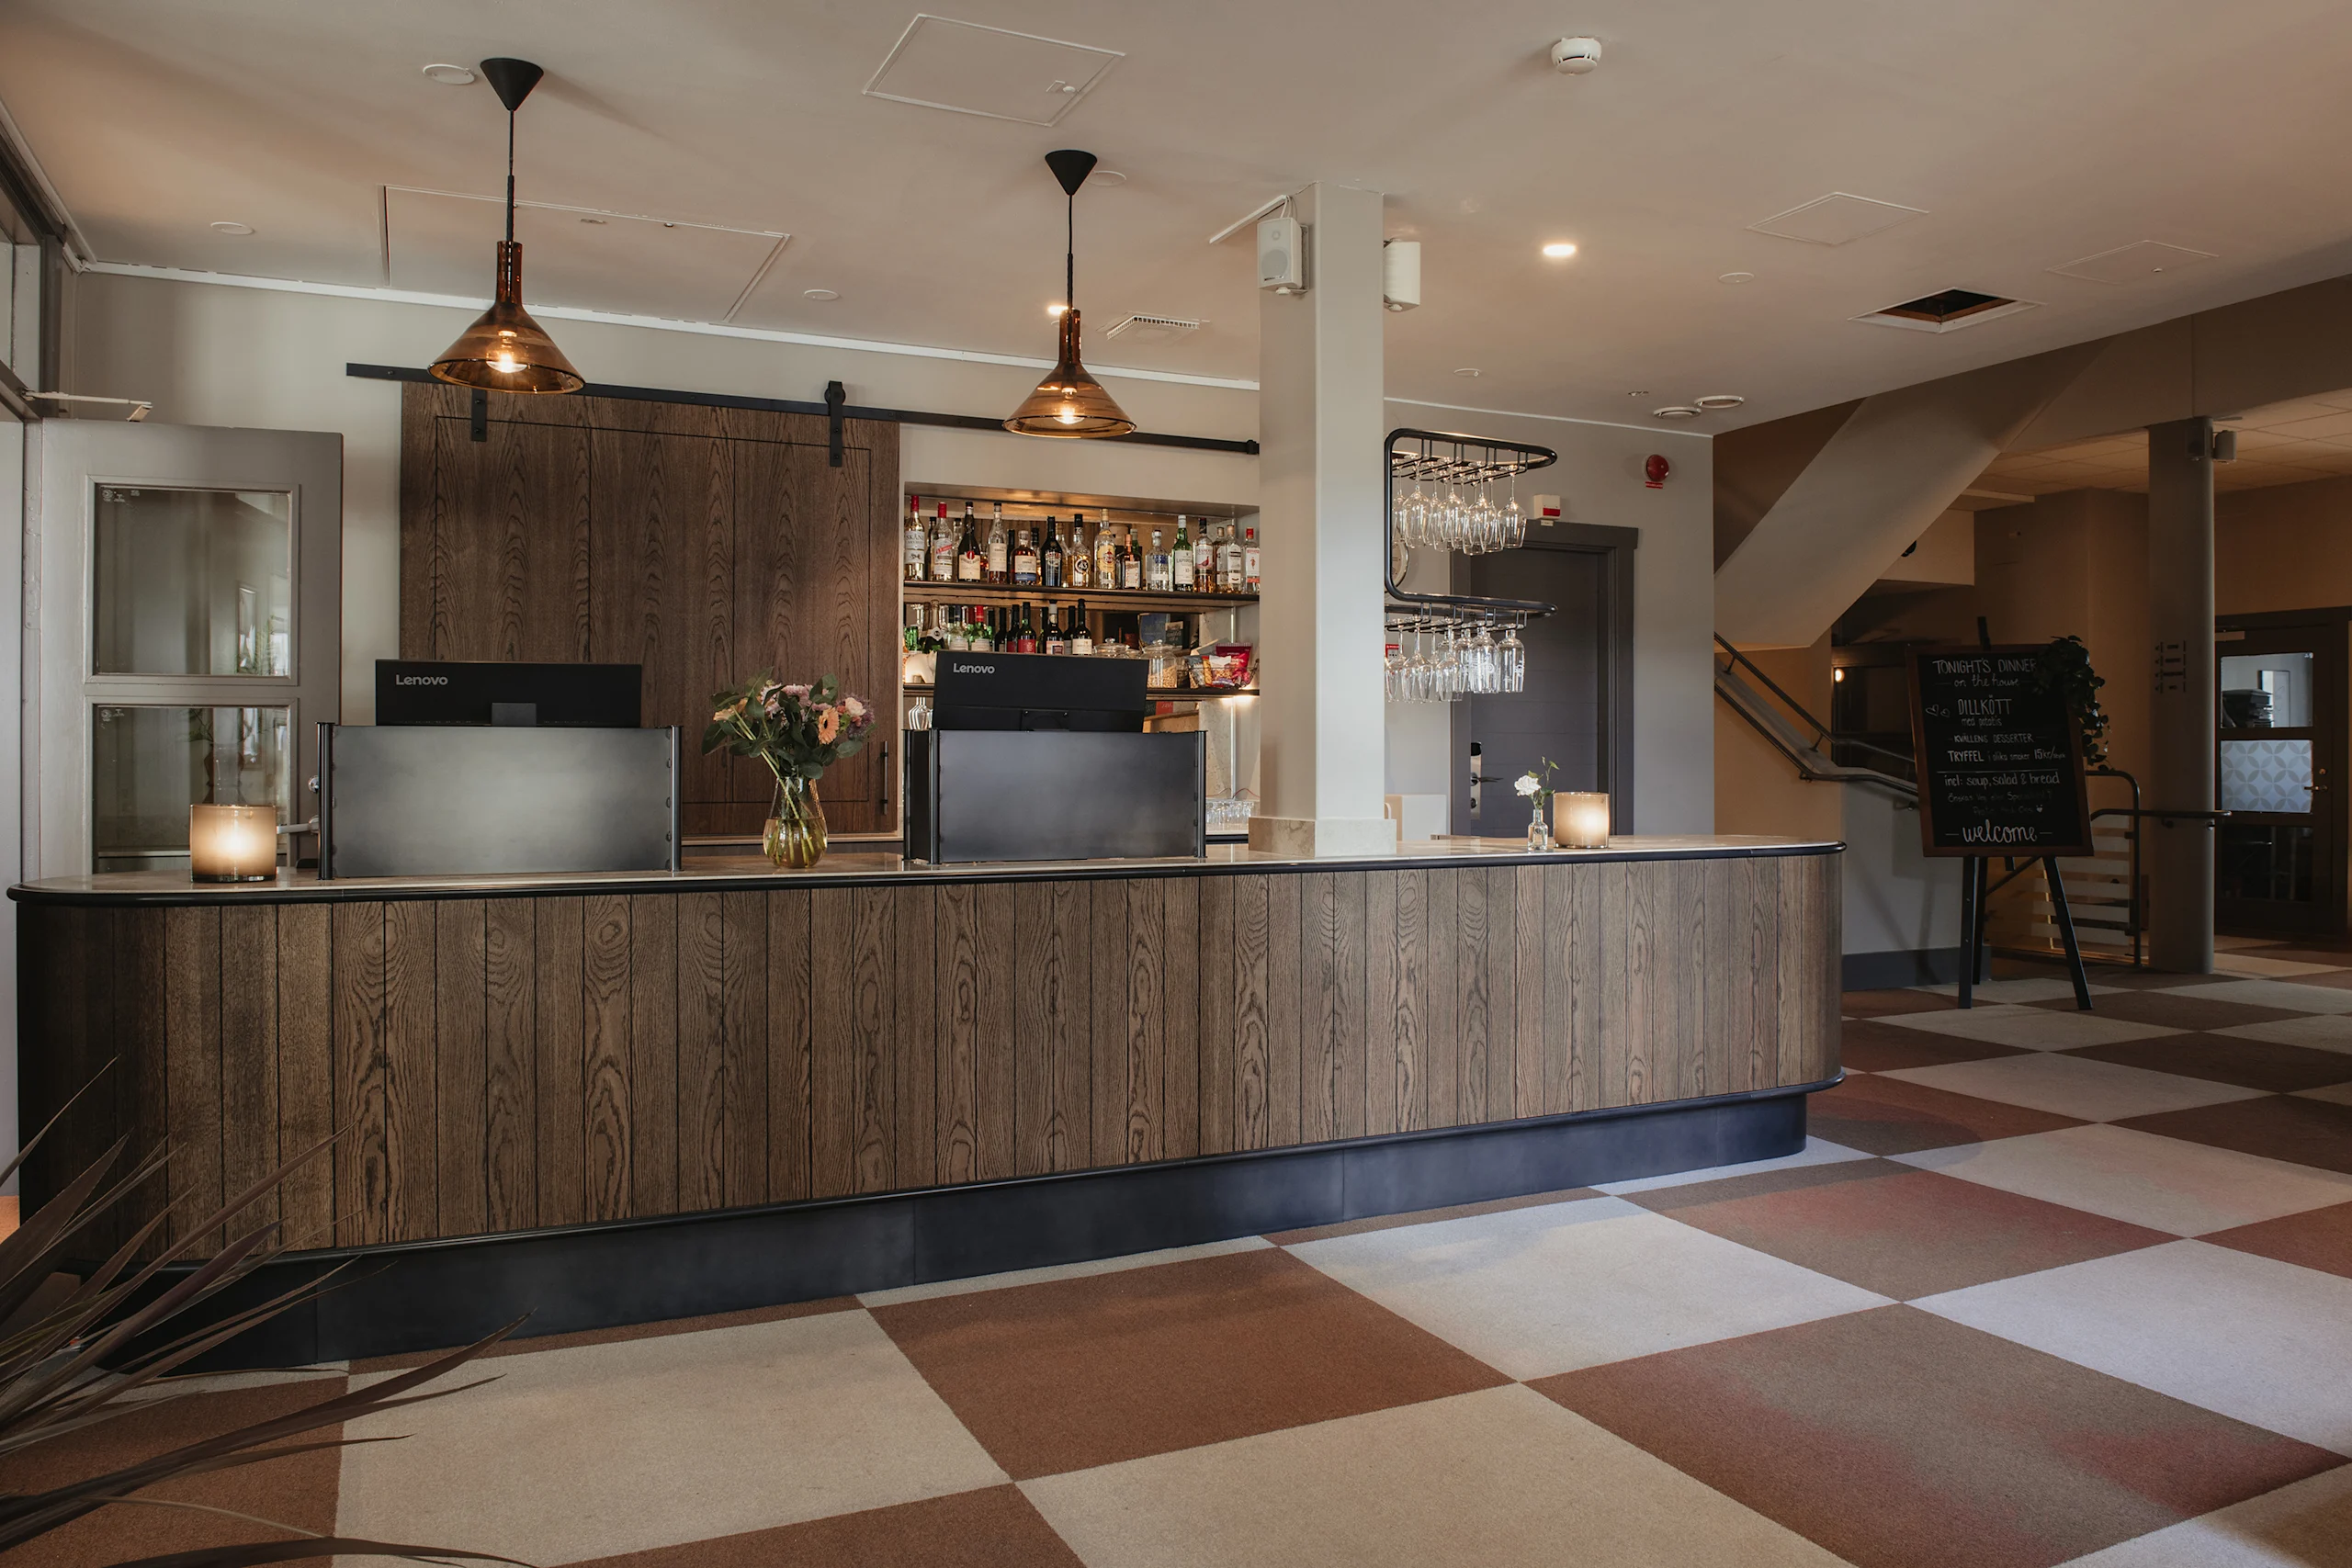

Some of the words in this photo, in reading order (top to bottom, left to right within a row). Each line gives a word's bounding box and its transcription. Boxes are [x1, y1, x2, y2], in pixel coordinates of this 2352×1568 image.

[953, 662, 995, 674] Lenovo
[1997, 658, 2037, 672] DINNER
[395, 674, 448, 685] Lenovo
[1953, 678, 1967, 687] on
[1972, 673, 1990, 687] the
[1991, 673, 2019, 687] house
[1957, 694, 2013, 716] DILLKÖTT
[1961, 716, 1975, 727] med
[1953, 732, 1988, 743] KVÄLLENS
[1993, 732, 2035, 744] DESSERTER
[1947, 750, 1984, 762] TRYFFEL
[1992, 773, 2018, 786] salad
[2029, 772, 2060, 784] bread
[1962, 818, 2038, 843] welcome
